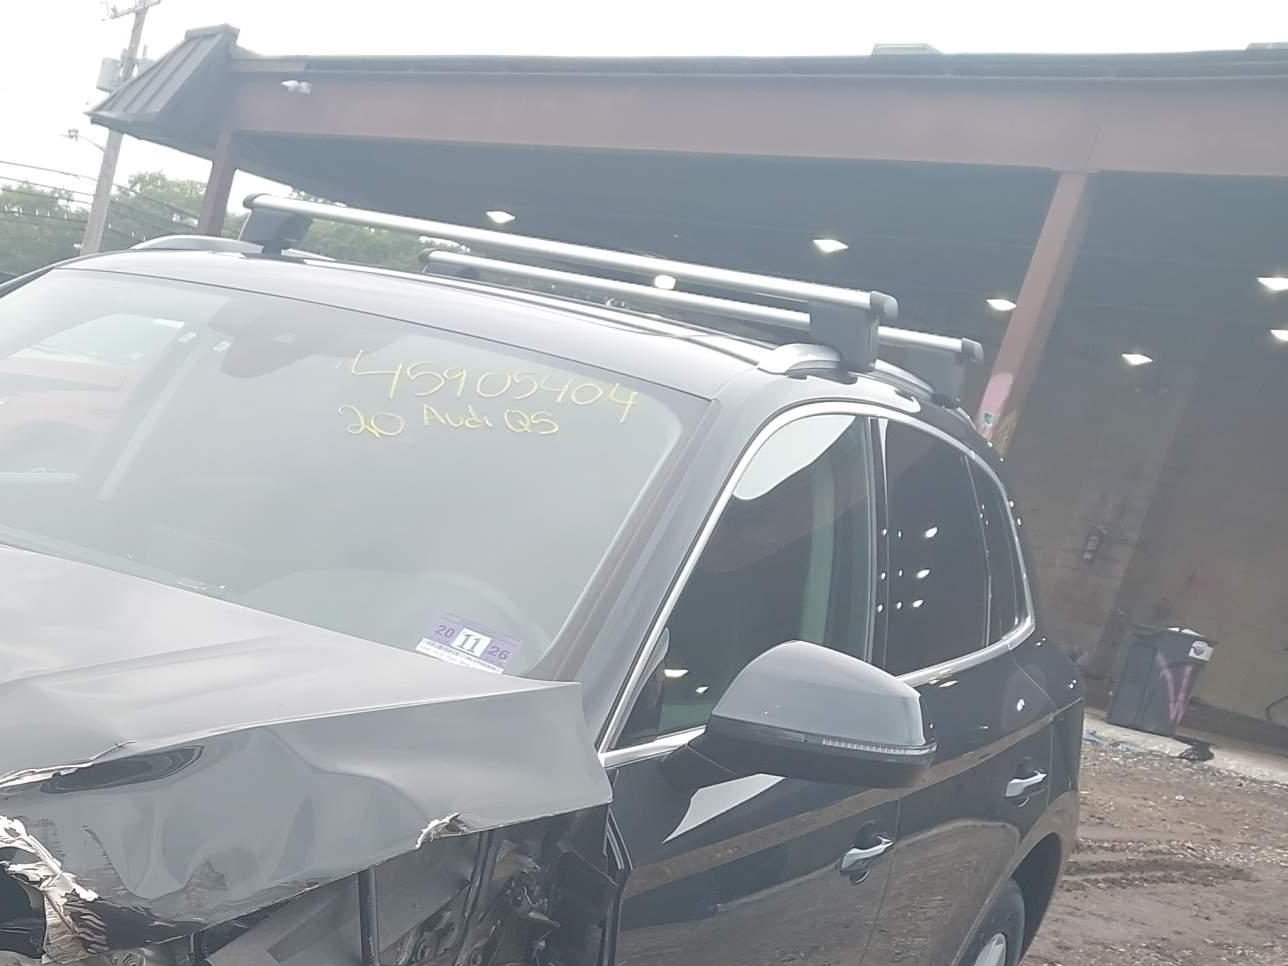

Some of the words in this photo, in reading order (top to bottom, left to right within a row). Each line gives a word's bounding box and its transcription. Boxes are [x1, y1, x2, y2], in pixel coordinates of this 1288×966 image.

[351, 349, 638, 423] 45905404
[338, 404, 406, 438] 20
[423, 403, 494, 430] Audi
[434, 624, 456, 639] 20
[457, 633, 482, 654] 11
[488, 645, 510, 661] 26
